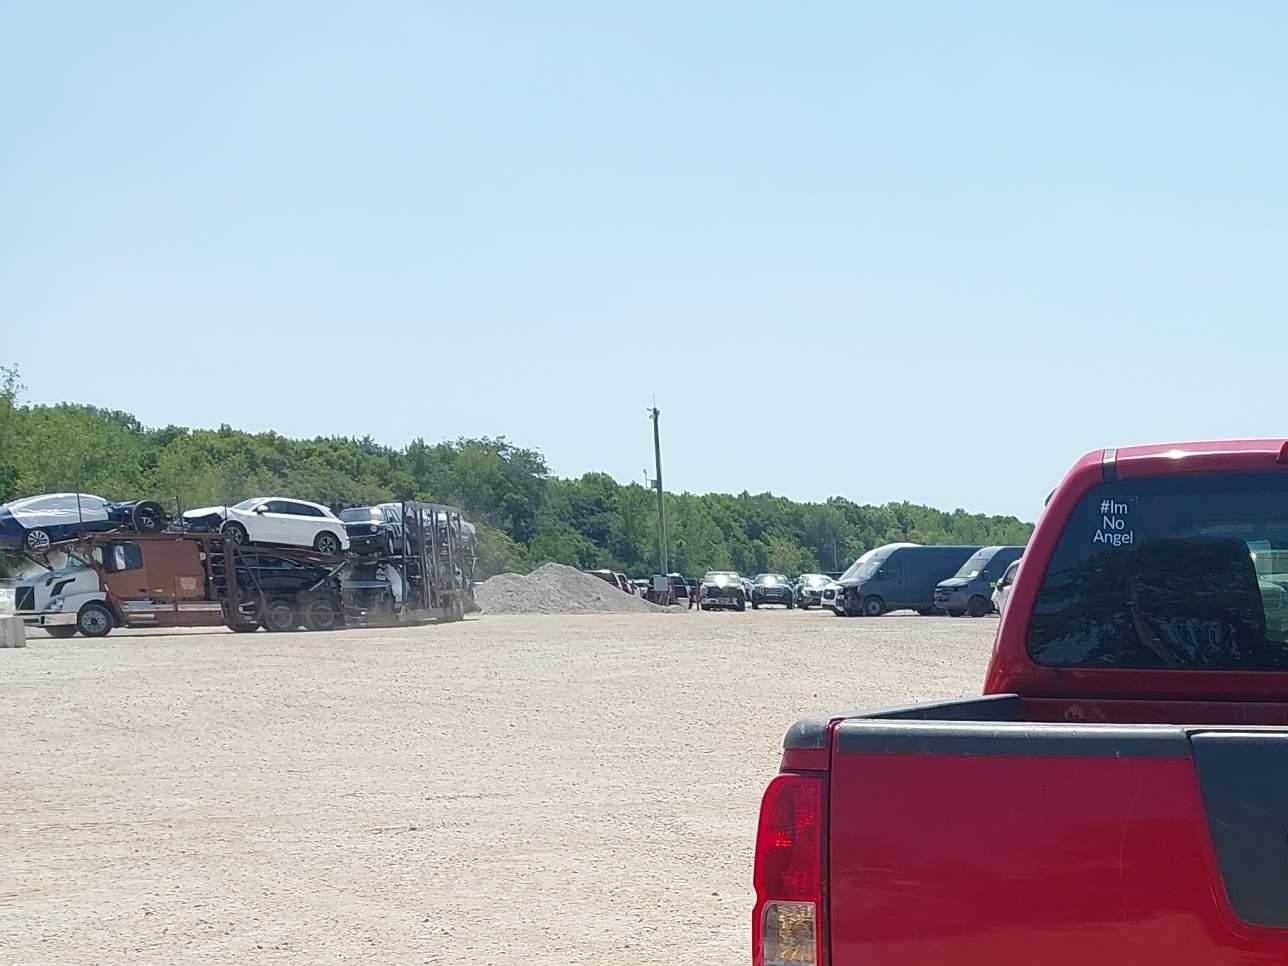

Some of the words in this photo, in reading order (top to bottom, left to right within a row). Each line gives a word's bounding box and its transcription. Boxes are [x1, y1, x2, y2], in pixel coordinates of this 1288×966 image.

[1100, 500, 1128, 515] #Im
[1103, 516, 1125, 530] No
[1093, 530, 1134, 547] Angel
